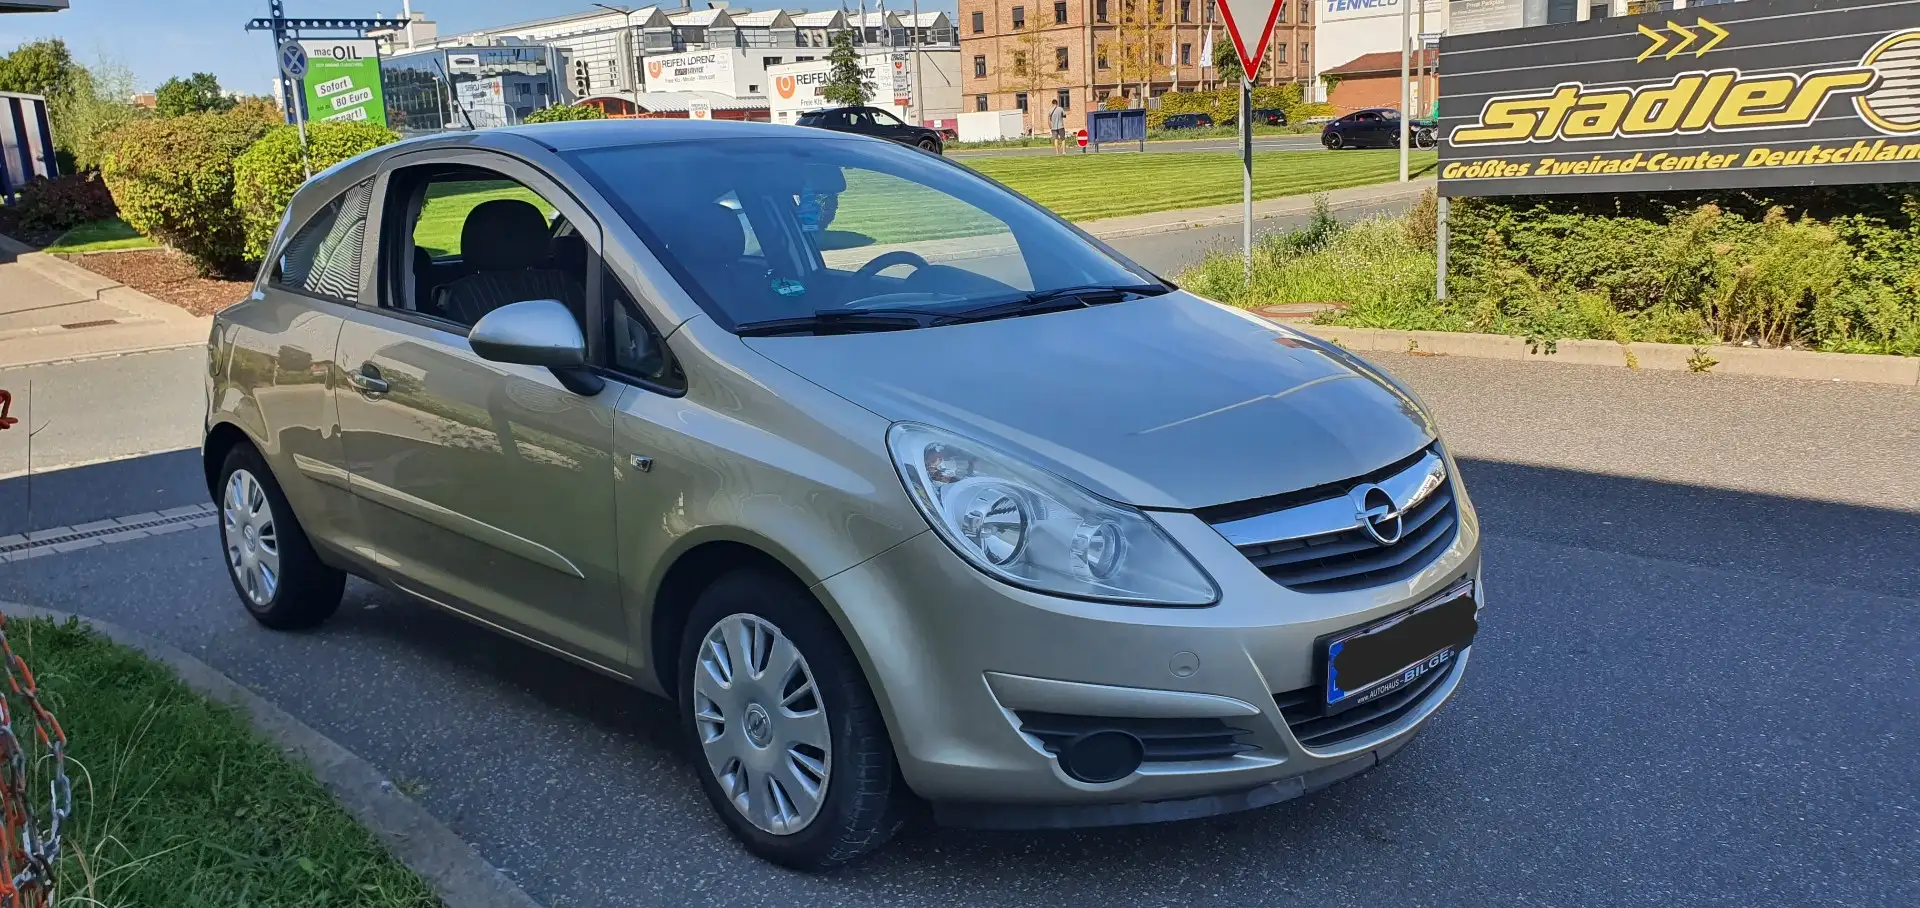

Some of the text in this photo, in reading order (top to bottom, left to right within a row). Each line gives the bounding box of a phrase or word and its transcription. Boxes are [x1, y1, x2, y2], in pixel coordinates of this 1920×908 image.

[332, 46, 362, 60] OIL
[661, 58, 686, 68] REIFEN
[687, 54, 716, 66] LORENZ
[796, 71, 831, 85] REIFEN
[320, 79, 348, 94] Sofort
[336, 92, 369, 106] 80 Euro
[1449, 67, 1880, 147] stadler
[1442, 139, 1920, 179] Größtes Zweirad-Center Deutschlan
